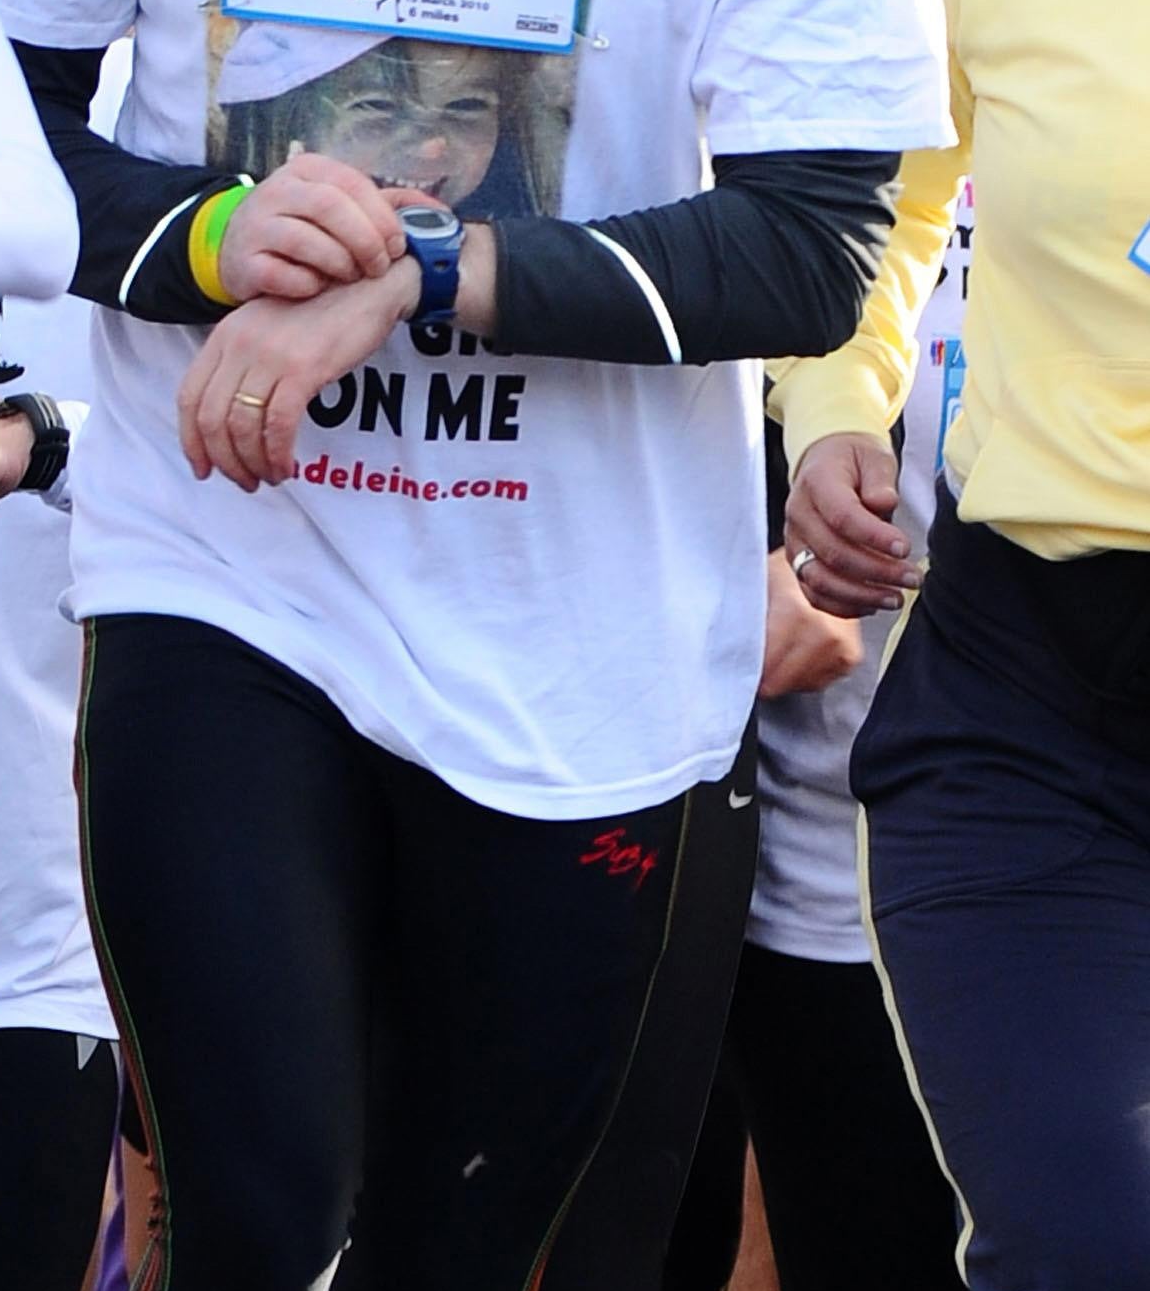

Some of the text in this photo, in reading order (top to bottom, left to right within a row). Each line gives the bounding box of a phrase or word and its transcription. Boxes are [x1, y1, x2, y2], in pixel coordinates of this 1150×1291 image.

[408, 6, 460, 23] 6 miles
[459, 0, 491, 12] 2010
[307, 366, 527, 441] ON ME
[294, 454, 528, 501] deleine.com
